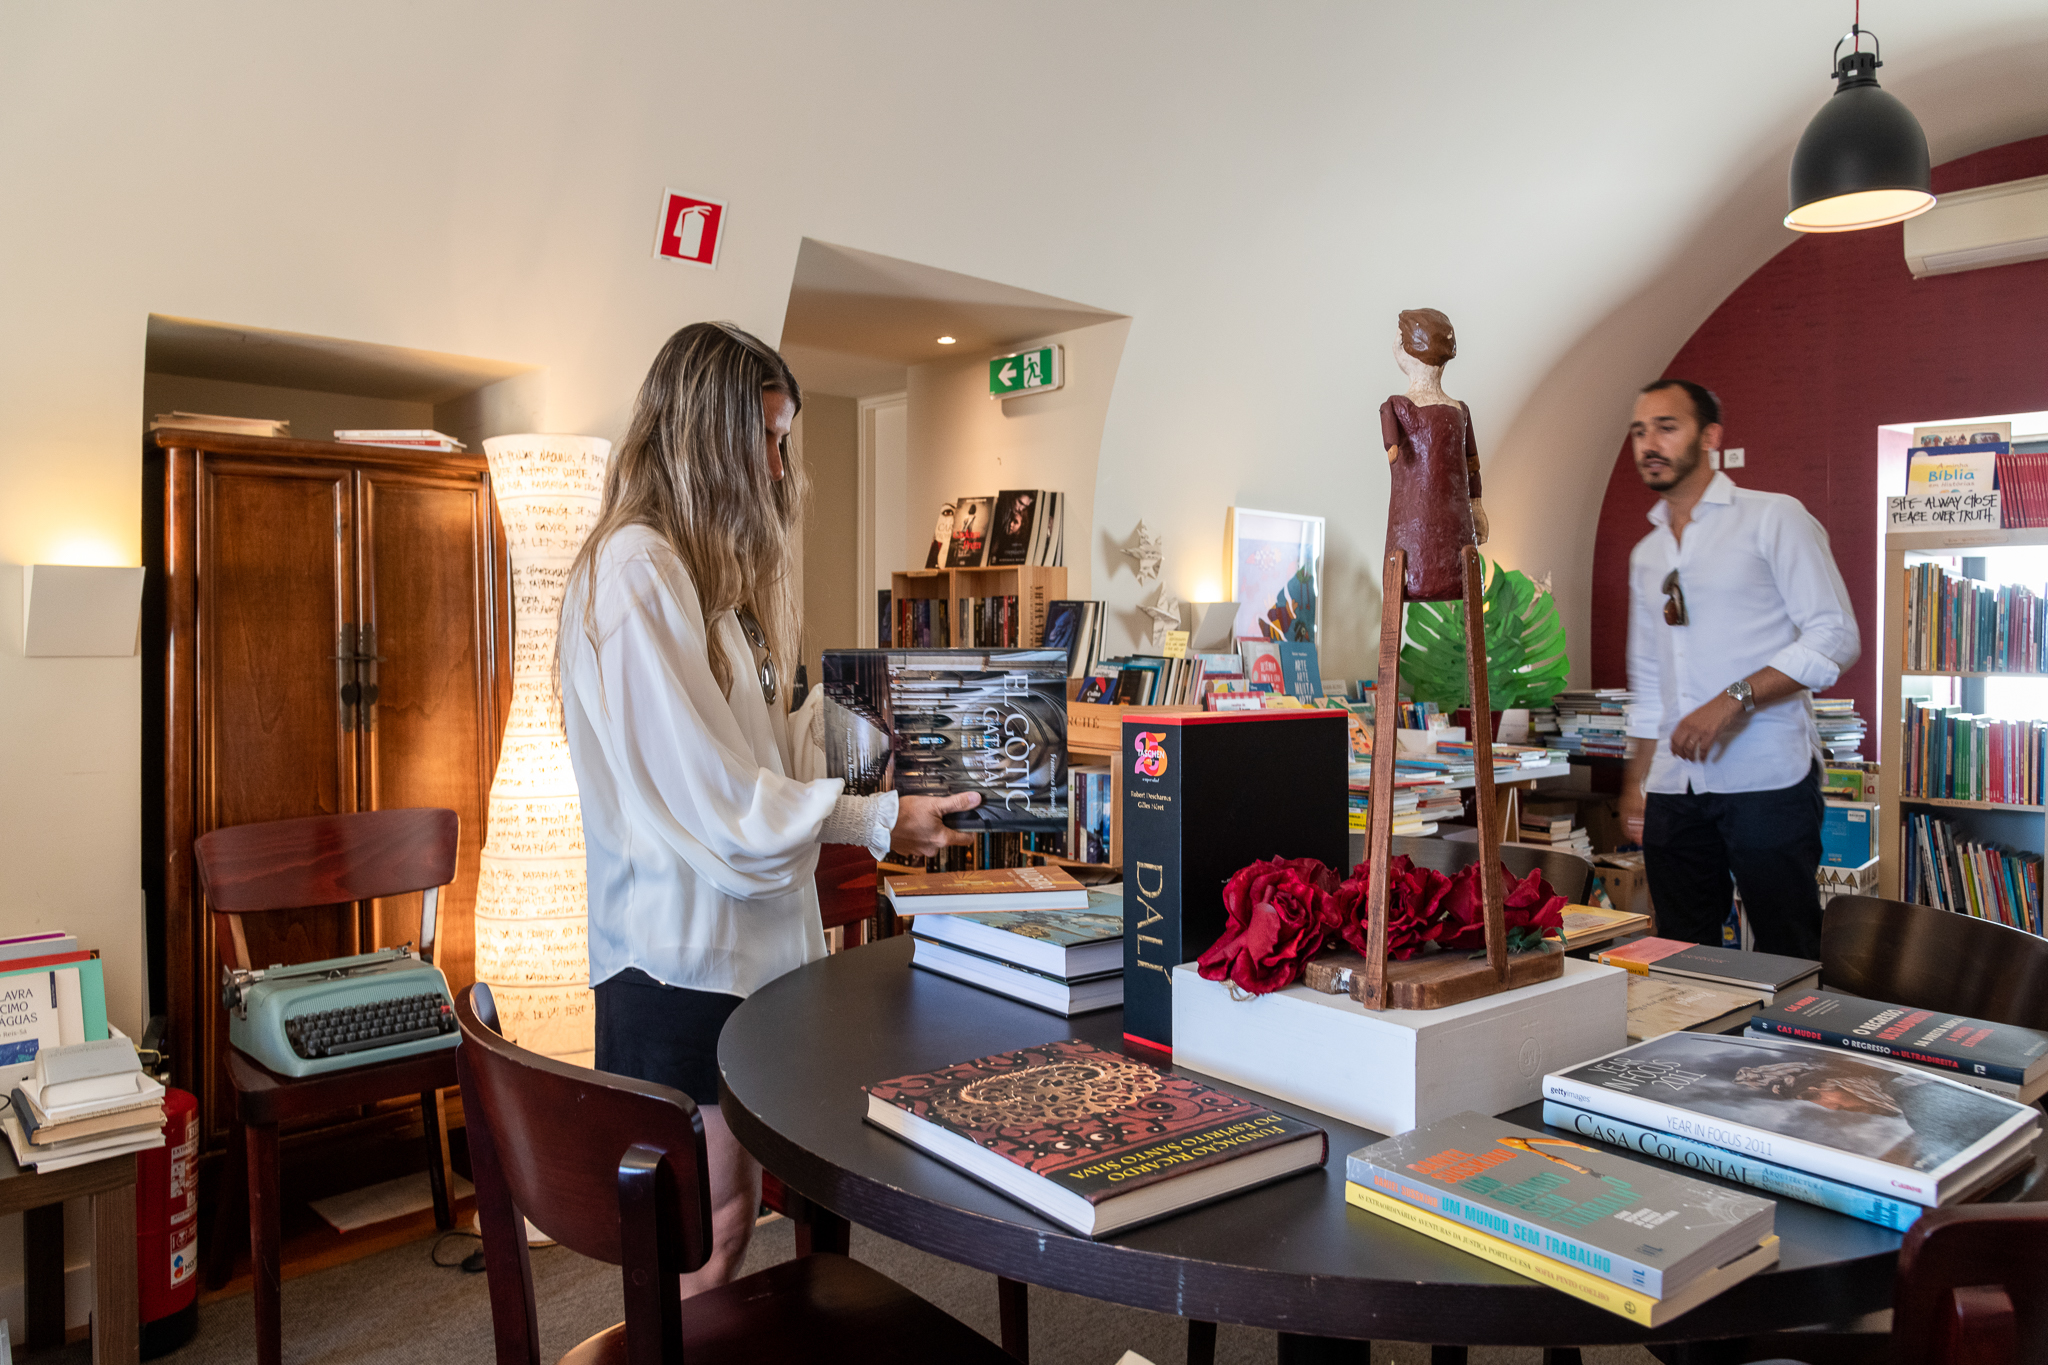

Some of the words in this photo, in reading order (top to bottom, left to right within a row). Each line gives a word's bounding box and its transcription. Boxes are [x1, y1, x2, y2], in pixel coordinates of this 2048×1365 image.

[1928, 469, 1975, 482] Bíblia
[1891, 497, 1922, 511] SHE
[1926, 495, 1962, 510] ALWAY
[1964, 493, 1997, 509] CHOSE
[1892, 510, 1927, 524] PEACE
[1932, 510, 1956, 523] OVER
[1003, 673, 1029, 708] EL
[983, 706, 1004, 784] CATALÀ
[1137, 748, 1165, 759] TASCHEN
[1004, 712, 1036, 812] GÒTIC
[1130, 790, 1146, 799] Robert
[1136, 861, 1172, 985] DALÍ
[1777, 1024, 1792, 1034] CAS
[1794, 1028, 1822, 1040] MUDDE
[1861, 1009, 1904, 1030] REGRESSO
[1590, 1058, 1641, 1074] YEAR
[1842, 1038, 1850, 1046] O
[1851, 1041, 1891, 1055] REGRESSO
[1900, 1051, 1959, 1069] ULTRADIREITA
[1602, 1079, 1634, 1092] IN
[1618, 1058, 1682, 1085] FOCUS
[1651, 1068, 1707, 1091] 2011
[1550, 1085, 1591, 1103] gettyimages
[1253, 1114, 1282, 1127] DO
[1180, 1121, 1251, 1147] ESPÍRITO
[1191, 1125, 1286, 1156] FUNDAÇÃO
[1666, 1115, 1692, 1132] YEAR
[1694, 1123, 1705, 1138] IN
[1707, 1125, 1742, 1148] FOCUS
[1744, 1136, 1773, 1157] 2011
[1120, 1142, 1183, 1165] SANTO
[1406, 1149, 1475, 1174] DANIEL
[1574, 1114, 1631, 1149] CASA
[1638, 1132, 1755, 1185] COLONIAL
[1068, 1160, 1123, 1180] SILVA
[1107, 1151, 1196, 1181] RICARDO
[1431, 1149, 1518, 1184] SUSSKIND
[1460, 1176, 1506, 1195] UM
[1489, 1172, 1571, 1205] MUNDO
[1519, 1193, 1577, 1218] SEM
[1530, 1176, 1643, 1229] TRABALHO
[1374, 1175, 1399, 1193] DANIEL
[1401, 1185, 1438, 1208] SUSSKIND
[1442, 1197, 1460, 1216] UM
[1464, 1204, 1509, 1235] MUNDO
[1513, 1223, 1540, 1246] SEM
[1545, 1235, 1612, 1274] TRABALHO
[1365, 1194, 1417, 1222] EXTRAORDINÁRIAS
[1418, 1219, 1452, 1237] AVENTURAS
[1452, 1232, 1462, 1242] DA
[1462, 1235, 1488, 1253] JUSTIÇA
[1488, 1246, 1532, 1271] PORTUGUESA
[1534, 1265, 1556, 1281] SOFIA
[1556, 1272, 1578, 1289] PINTO
[1578, 1281, 1610, 1303] COELHO
